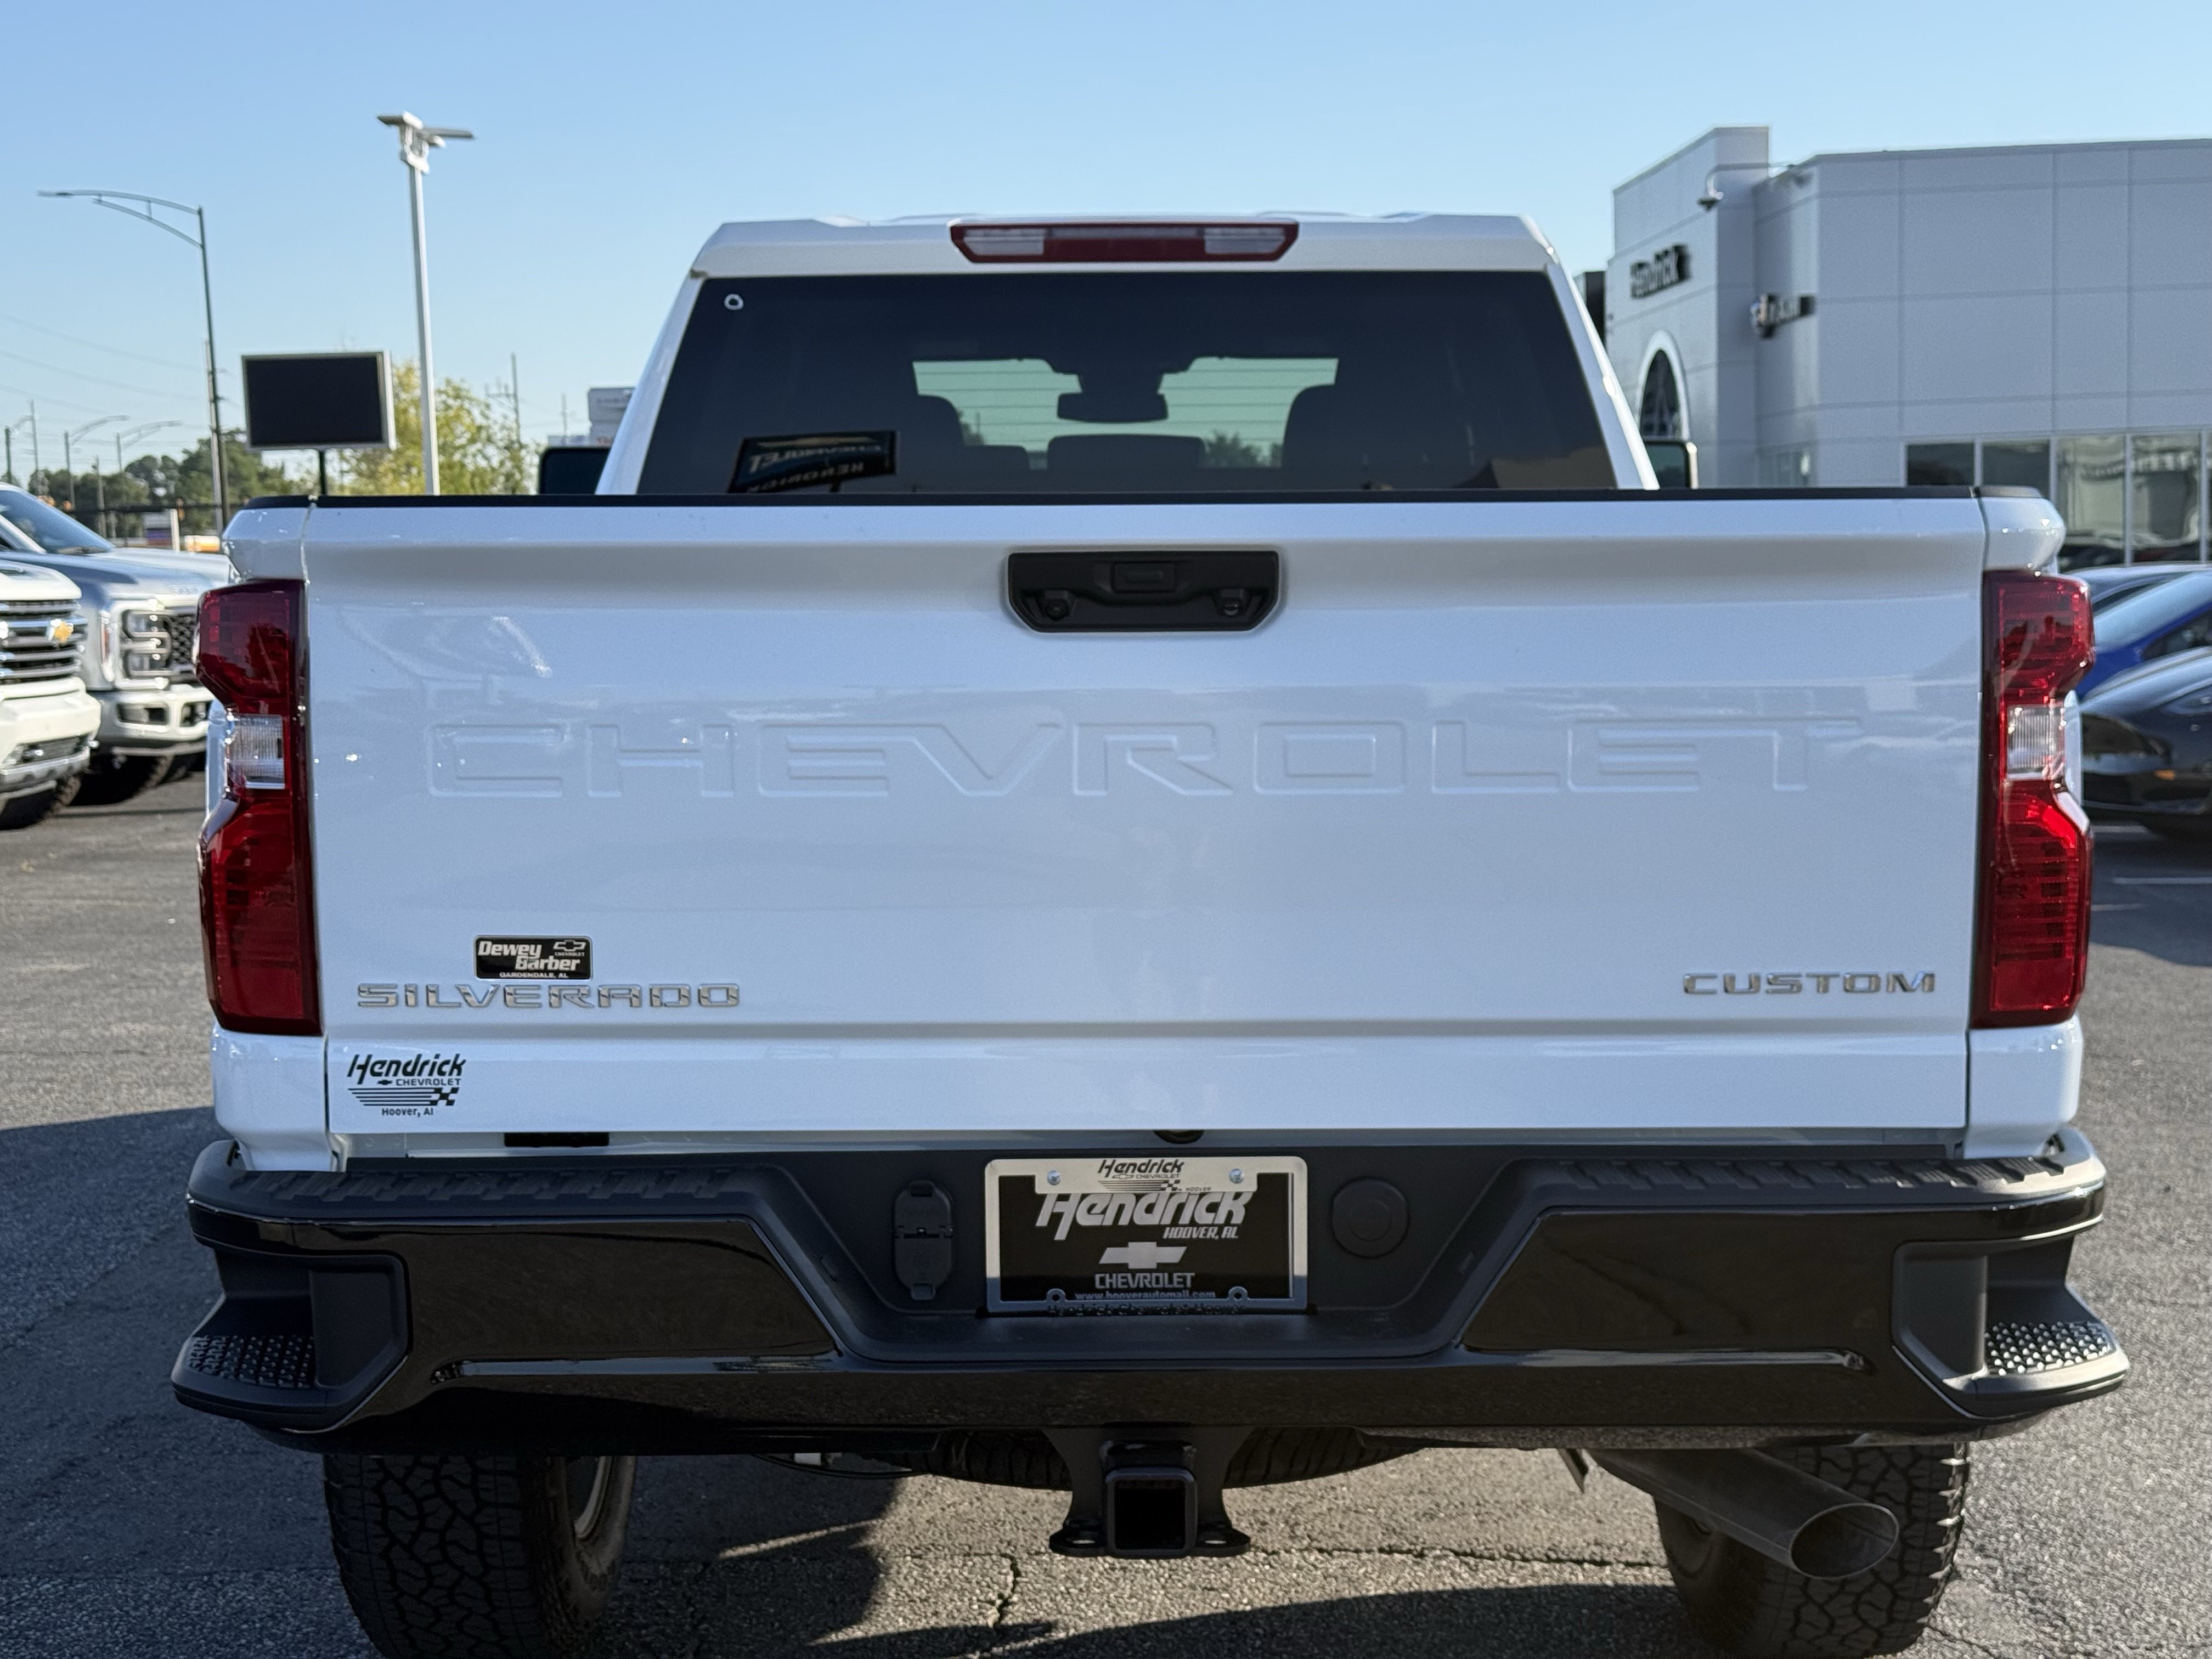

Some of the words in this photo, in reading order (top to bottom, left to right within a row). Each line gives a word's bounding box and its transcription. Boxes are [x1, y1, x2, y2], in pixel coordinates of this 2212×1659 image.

[426, 718, 1862, 798] CHEVROLET
[478, 940, 543, 959] Dewey
[514, 955, 581, 971] Barber
[1683, 970, 1936, 995] CUSTOM
[357, 983, 740, 1009] SILVERADO
[347, 1053, 466, 1085] Hendrick
[396, 1077, 462, 1086] CHEVROLET
[381, 1107, 421, 1118] Hoover,
[1097, 1159, 1185, 1178] Hendrick
[1035, 1191, 1256, 1241] Hendrick
[1163, 1226, 1219, 1240] HOOVER,
[1221, 1226, 1239, 1239] AL
[1094, 1272, 1195, 1289] CHEVROLET
[1074, 1290, 1216, 1301] www.hooverautomall.com
